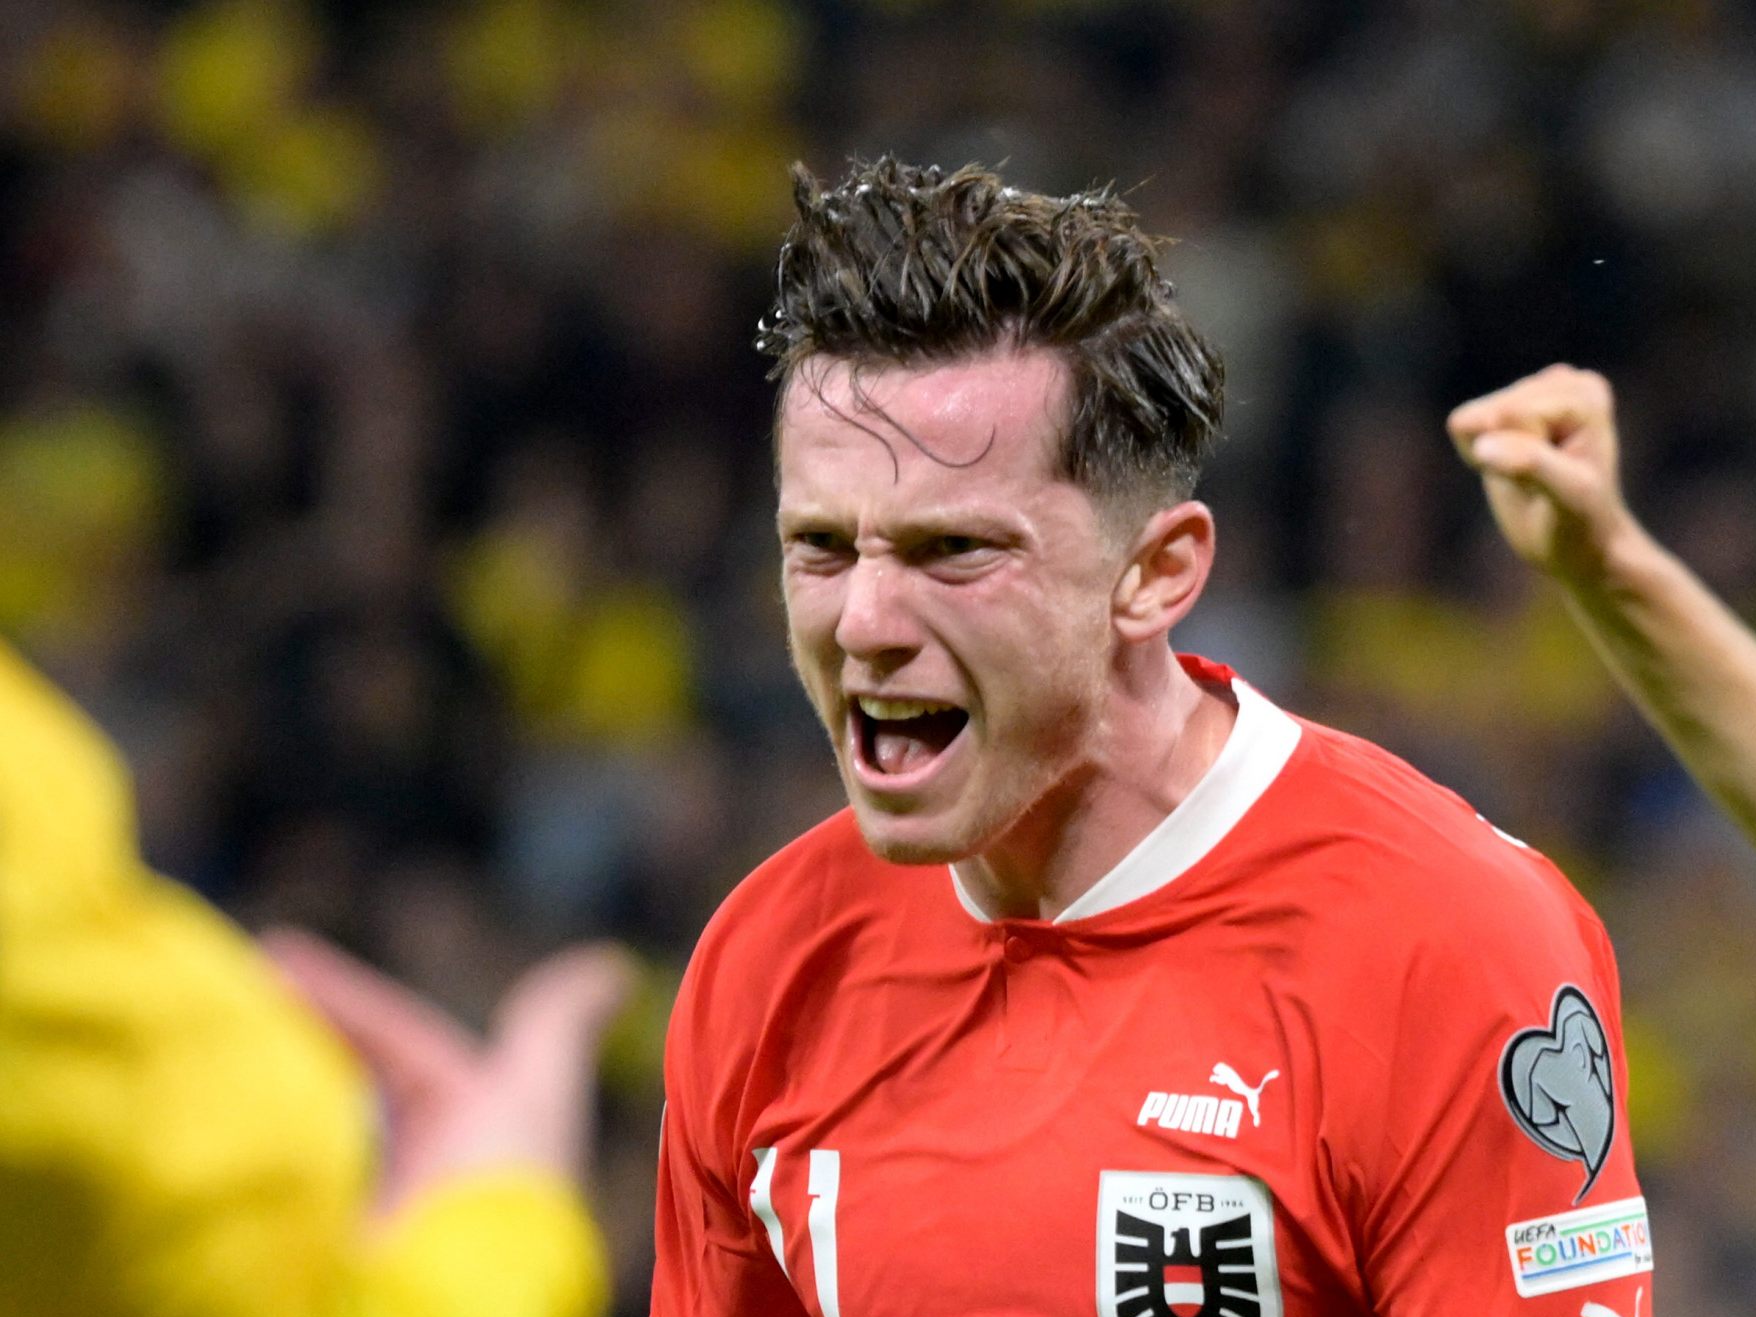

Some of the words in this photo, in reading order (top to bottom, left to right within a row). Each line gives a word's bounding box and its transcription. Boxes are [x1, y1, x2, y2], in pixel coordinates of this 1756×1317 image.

[1137, 1091, 1243, 1139] PUMA
[1149, 1187, 1215, 1213] ÖFB
[1514, 1223, 1556, 1244] UEFA
[1516, 1221, 1648, 1270] FOUNDATIO
